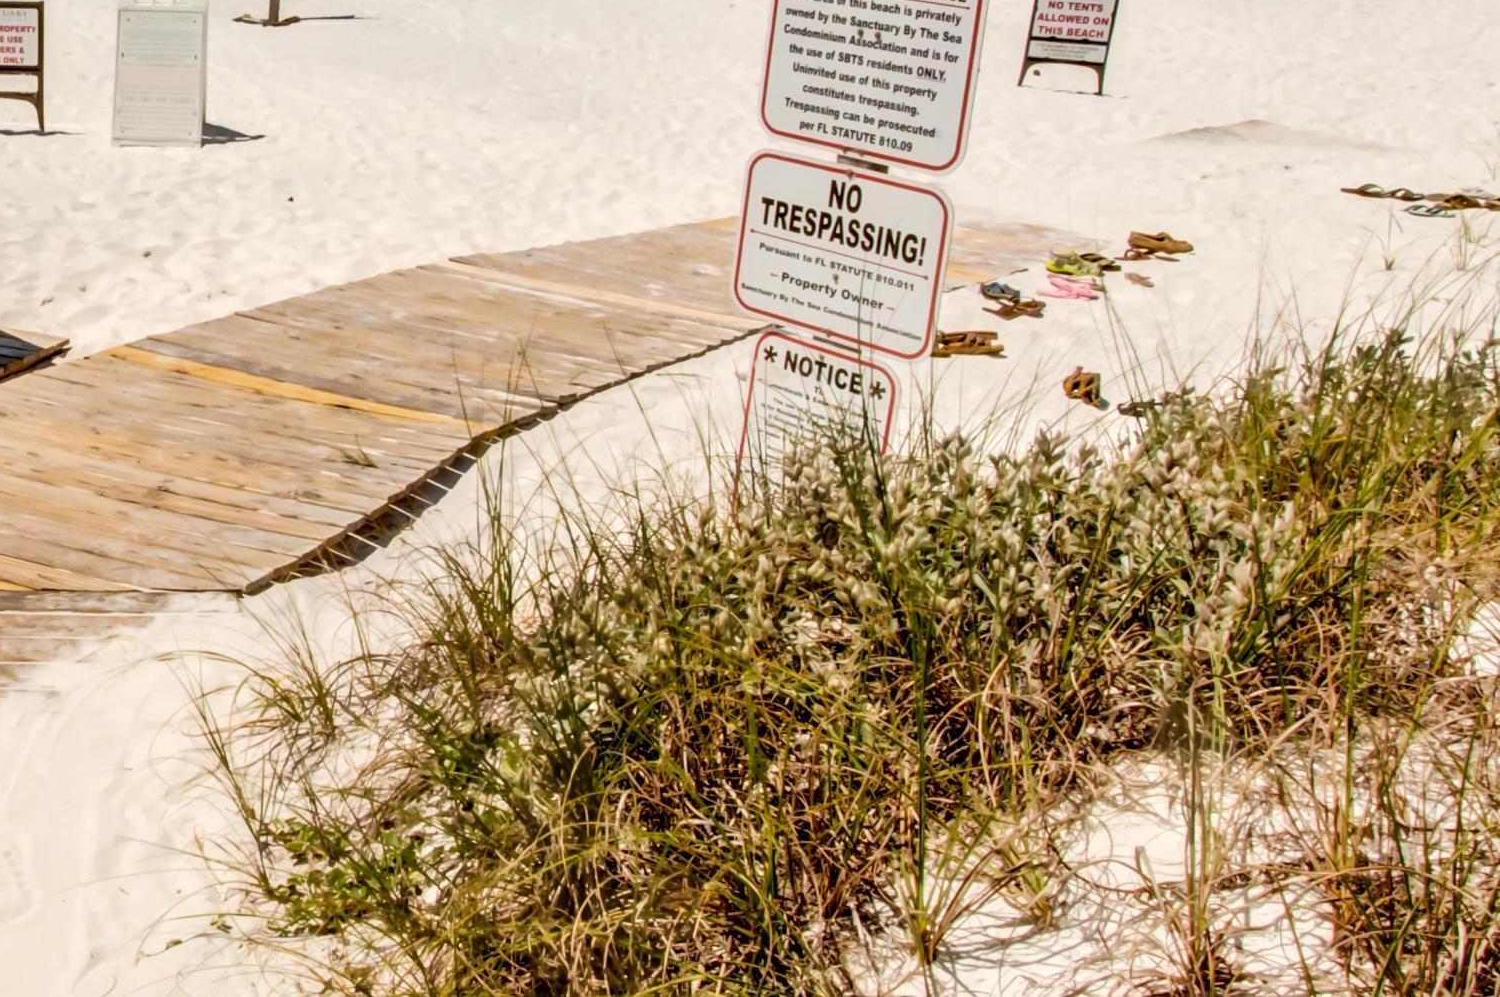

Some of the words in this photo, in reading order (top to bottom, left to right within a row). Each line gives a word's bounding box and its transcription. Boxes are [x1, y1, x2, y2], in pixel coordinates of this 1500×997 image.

[786, 7, 815, 19] owned
[818, 11, 829, 23] by
[832, 14, 847, 25] the
[850, 16, 901, 36] Sanctuary
[904, 25, 917, 38] By
[920, 27, 939, 40] The
[942, 32, 962, 42] Sea
[871, 1, 901, 14] beach
[903, 5, 912, 16] is
[915, 8, 962, 26] privately
[1038, 13, 1090, 24] ALLOWED
[1093, 17, 1109, 25] ON
[1048, 1, 1064, 9] NO
[1068, 2, 1103, 12] TENTS
[784, 24, 846, 43] Condominium
[849, 34, 907, 54] Association
[910, 48, 929, 59] and
[932, 49, 941, 60] is
[944, 51, 959, 64] for
[1038, 26, 1063, 35] THIS
[1067, 28, 1104, 38] BEACH
[789, 44, 804, 54] the
[806, 48, 822, 58] use
[825, 50, 835, 60] of
[837, 52, 863, 65] SBTS
[867, 59, 913, 75] residents
[916, 67, 946, 82] ONLY.
[792, 62, 836, 79] Uninvited
[839, 72, 855, 83] use
[859, 76, 869, 86] of
[872, 78, 890, 90] this
[893, 83, 937, 101] property
[785, 97, 840, 119] Trespassing
[842, 111, 860, 122] can
[863, 114, 875, 125] be
[878, 118, 936, 138] prosecuted
[803, 85, 856, 102] constitutes
[859, 95, 920, 117] trespassing.
[799, 121, 815, 130] per
[817, 123, 828, 134] FL
[831, 126, 876, 144] STATUTE
[879, 137, 912, 151] 810.09
[828, 180, 862, 213] NO
[762, 197, 927, 266] TRESPASSING!
[759, 243, 800, 261] Pursuant
[803, 254, 812, 263] to
[815, 258, 826, 267] FL
[829, 261, 873, 280] STATUTE
[876, 274, 915, 291] 810.011
[781, 272, 837, 297] Property
[841, 289, 884, 310] Owner
[741, 283, 778, 300] Sanctuary
[780, 294, 789, 303] By
[791, 296, 805, 306] The
[807, 302, 821, 311] Sea
[876, 318, 922, 341] Association
[784, 350, 863, 395] NOTICE
